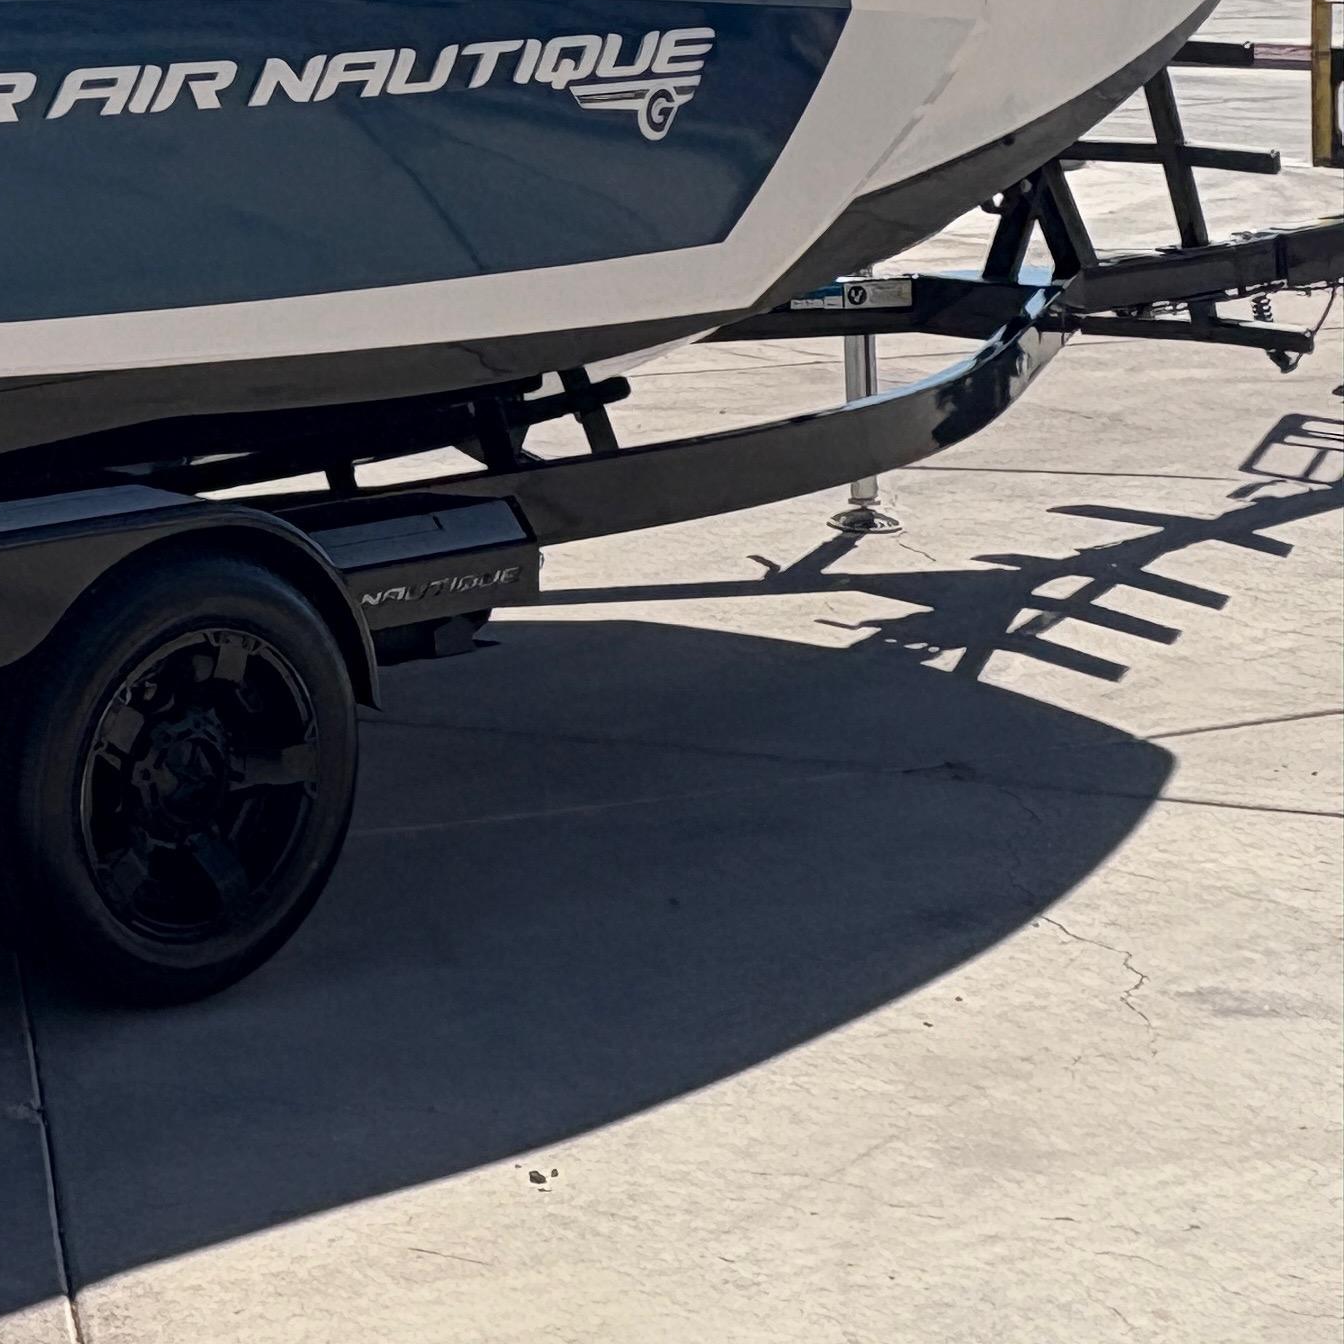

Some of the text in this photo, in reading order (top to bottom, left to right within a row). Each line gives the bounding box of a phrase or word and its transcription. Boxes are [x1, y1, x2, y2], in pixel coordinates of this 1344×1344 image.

[46, 60, 238, 120] AIR
[248, 27, 715, 107] NAUTIQUE
[361, 566, 520, 605] NAUTIQUE
